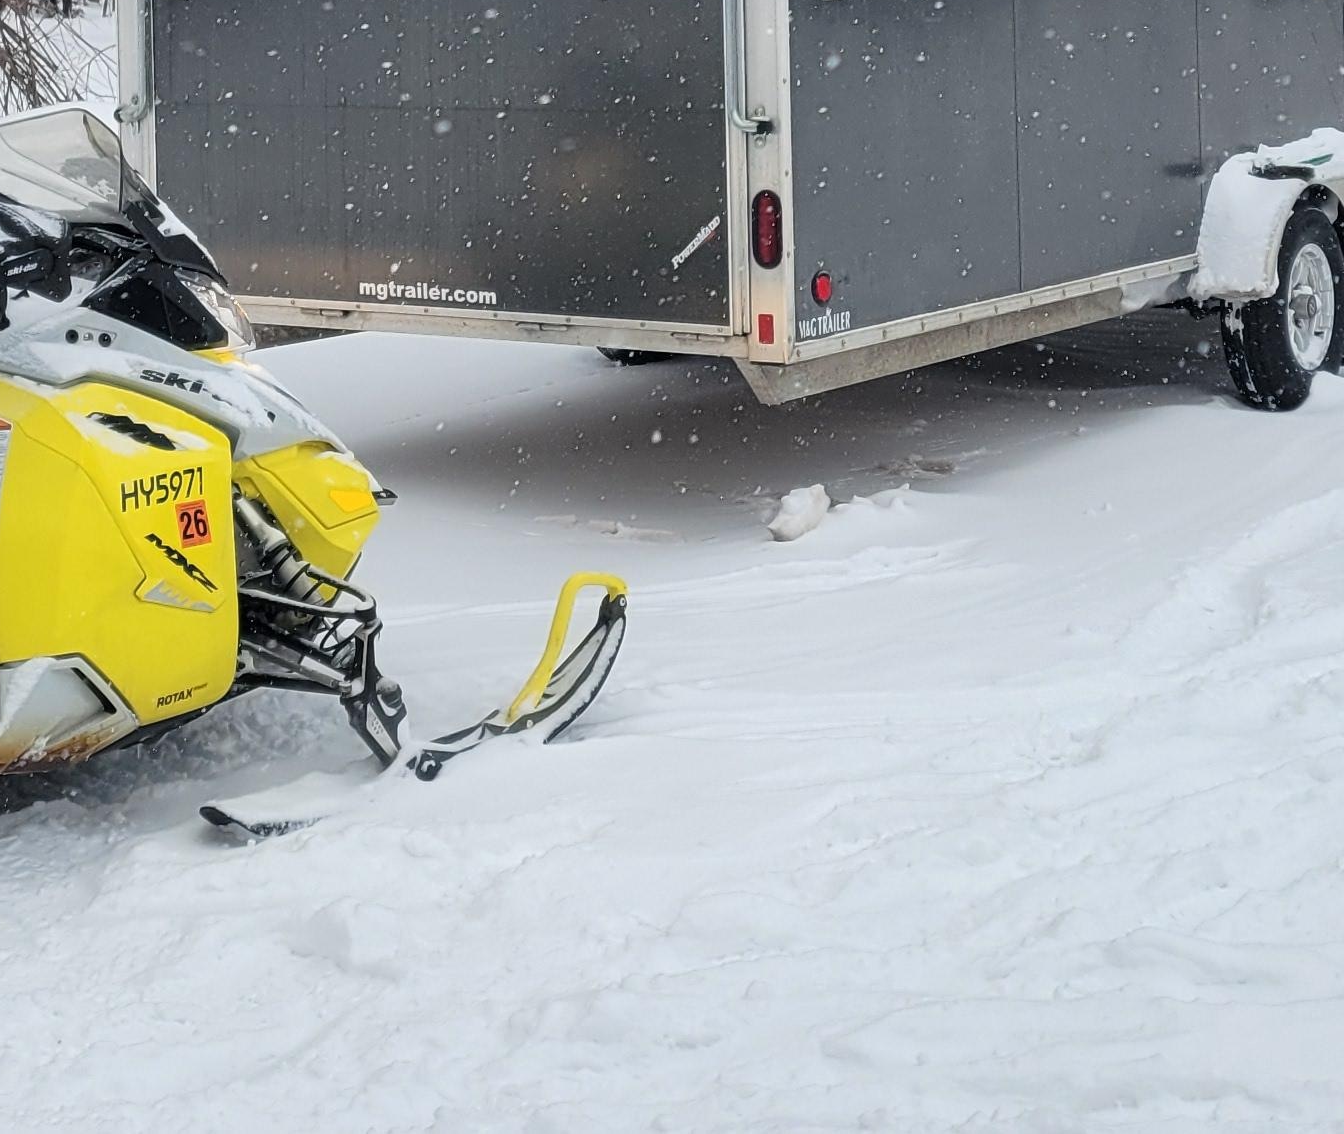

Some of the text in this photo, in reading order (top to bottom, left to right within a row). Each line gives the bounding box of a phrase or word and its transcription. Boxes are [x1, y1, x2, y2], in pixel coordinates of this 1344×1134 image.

[359, 281, 497, 305] mgtrailer.com
[817, 310, 851, 336] TRAILER
[120, 466, 204, 513] HY5971
[179, 508, 208, 541] 26
[156, 687, 194, 708] ROTAX
